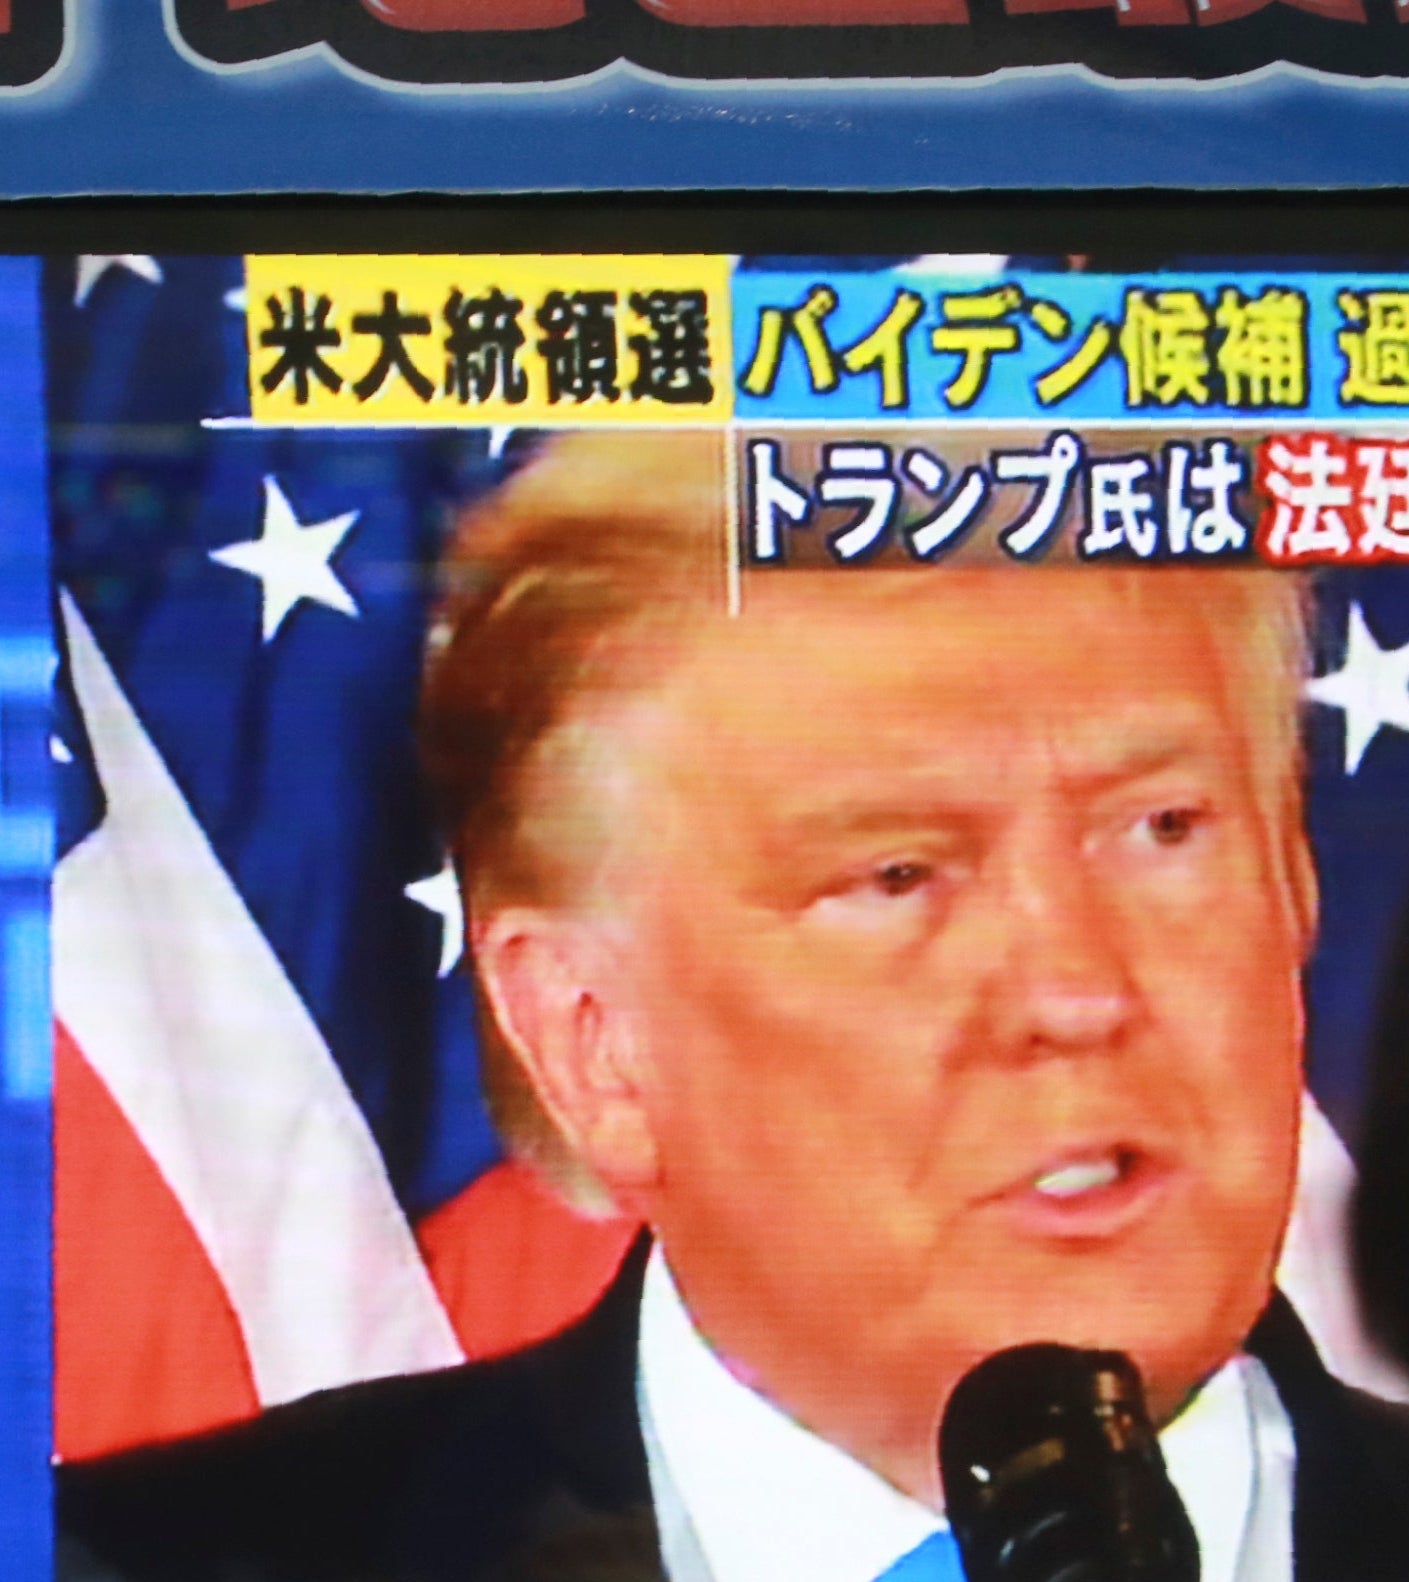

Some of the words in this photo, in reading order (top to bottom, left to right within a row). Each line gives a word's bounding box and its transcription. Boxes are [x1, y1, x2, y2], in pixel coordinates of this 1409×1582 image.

[259, 284, 716, 406] 米大統領選
[741, 283, 1308, 408] バイデン候補
